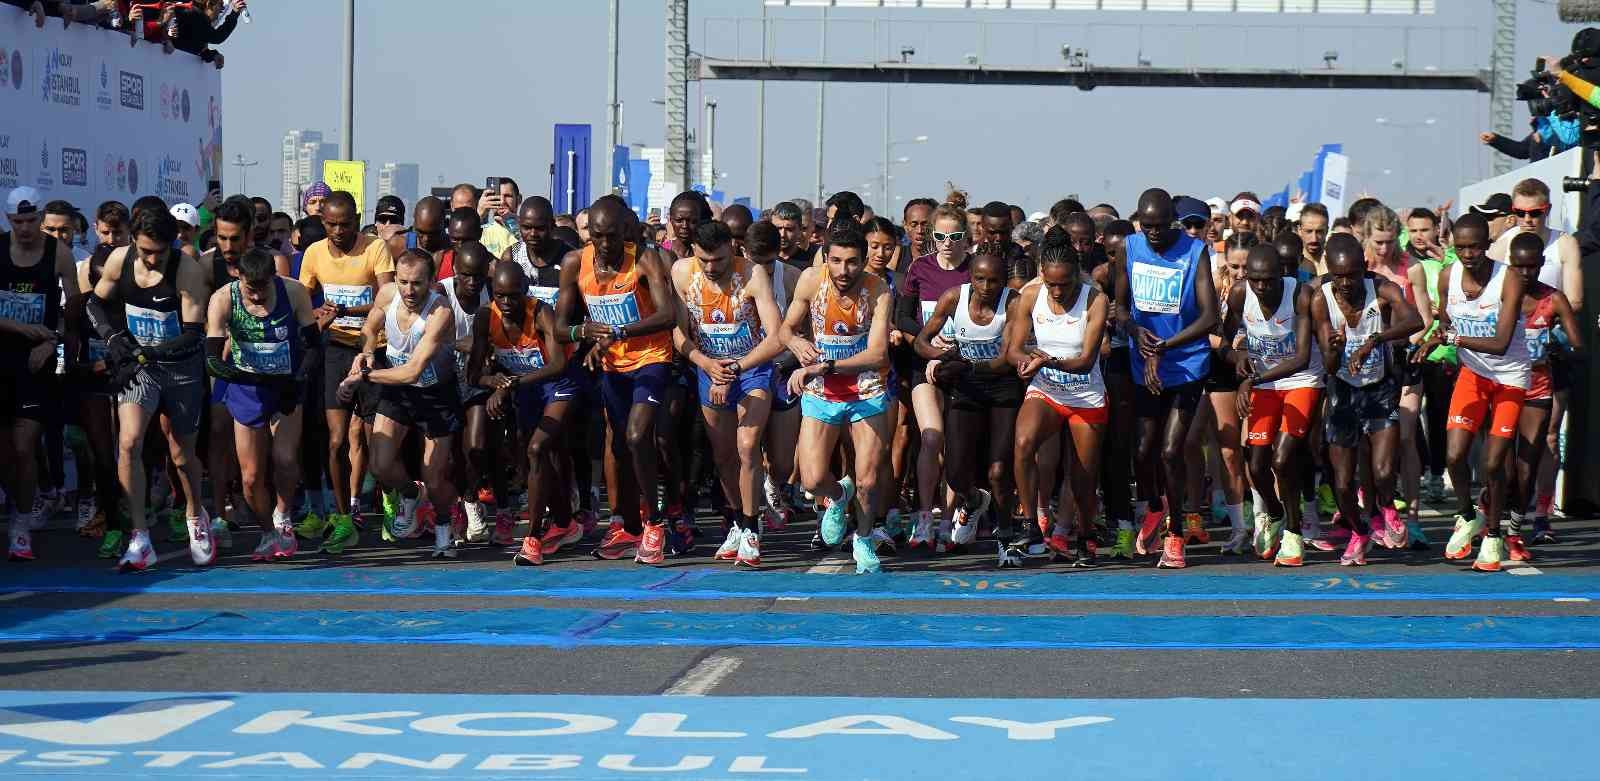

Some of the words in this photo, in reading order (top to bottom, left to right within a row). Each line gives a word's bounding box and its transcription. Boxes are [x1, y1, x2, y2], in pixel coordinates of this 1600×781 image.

[1133, 274, 1166, 300] DAVID
[591, 305, 625, 324] BRIAN
[232, 710, 1115, 741] KOLAY
